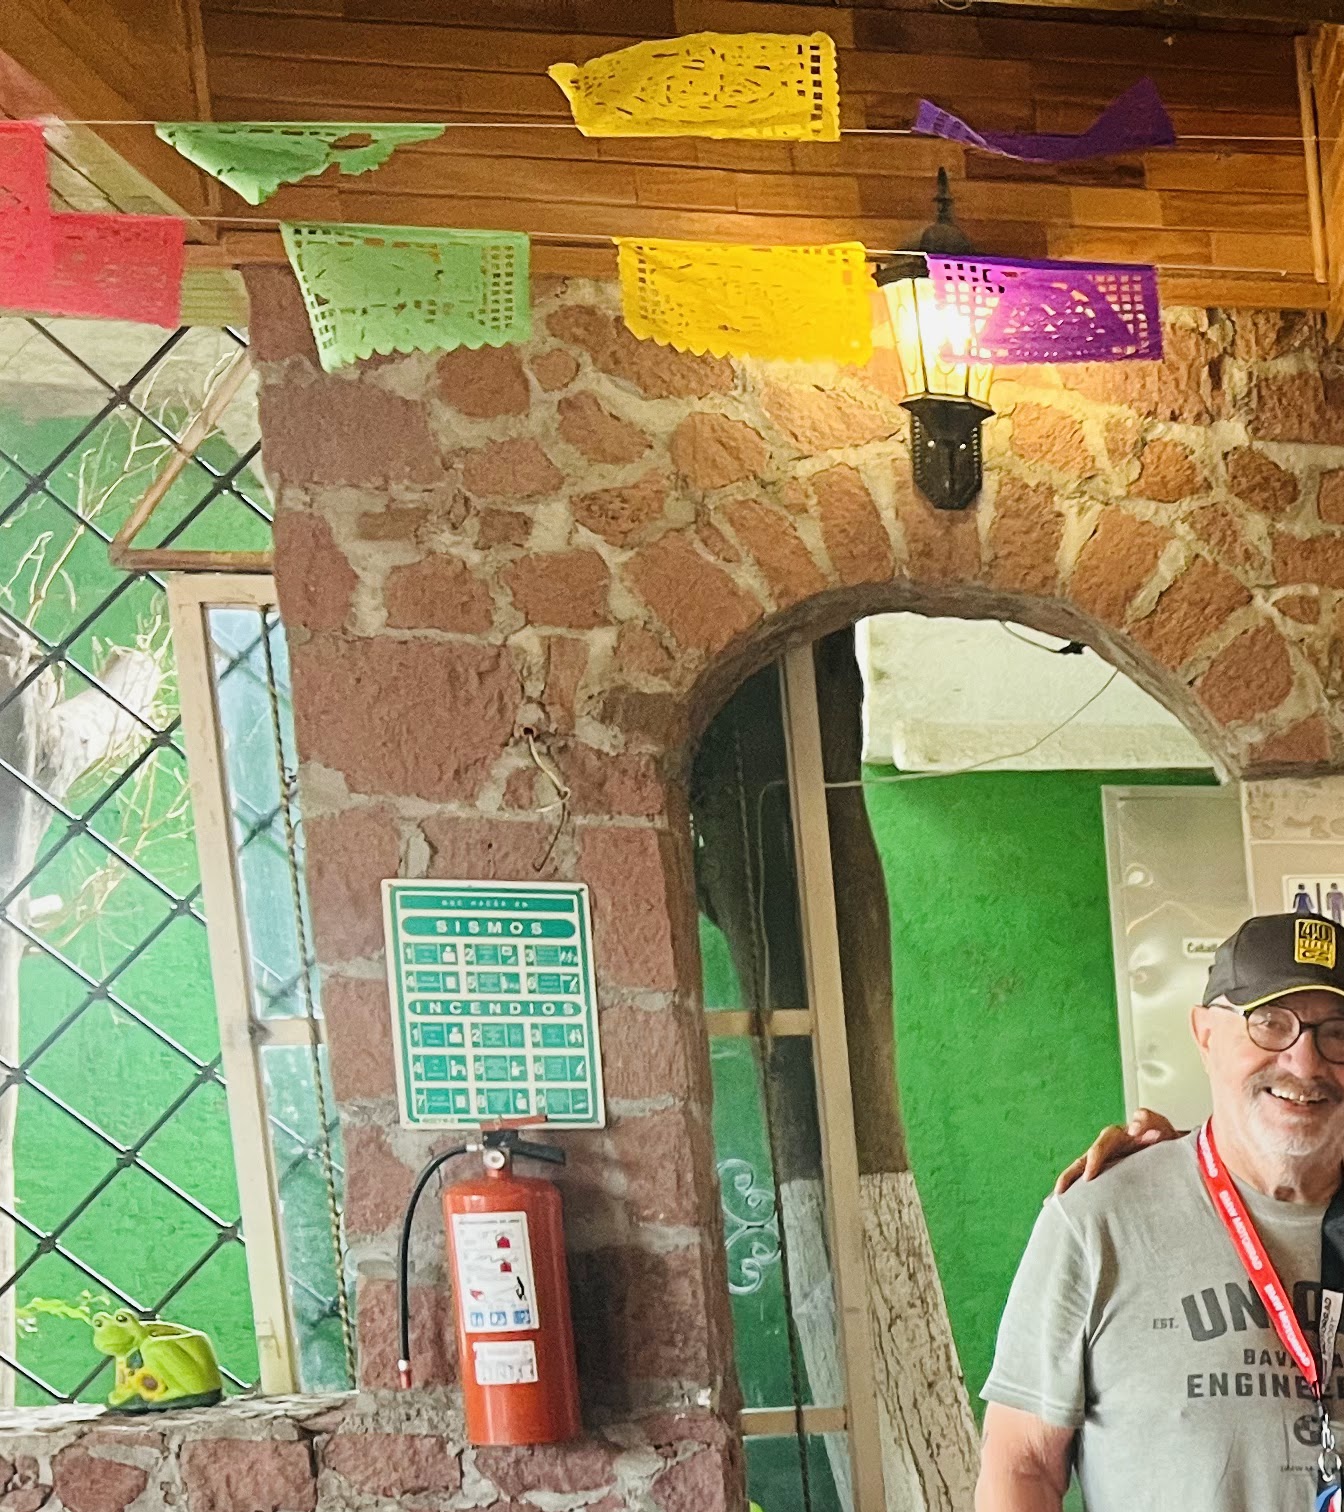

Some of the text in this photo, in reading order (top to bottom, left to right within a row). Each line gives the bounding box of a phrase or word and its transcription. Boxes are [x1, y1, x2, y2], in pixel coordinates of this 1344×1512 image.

[436, 920, 543, 936] SISMOS
[416, 1002, 574, 1016] INCENDIOS
[1219, 1190, 1263, 1270] BMW MOTORRAD
[1153, 1317, 1179, 1330] EST.
[1264, 1284, 1311, 1367] BMW MOTORRAD
